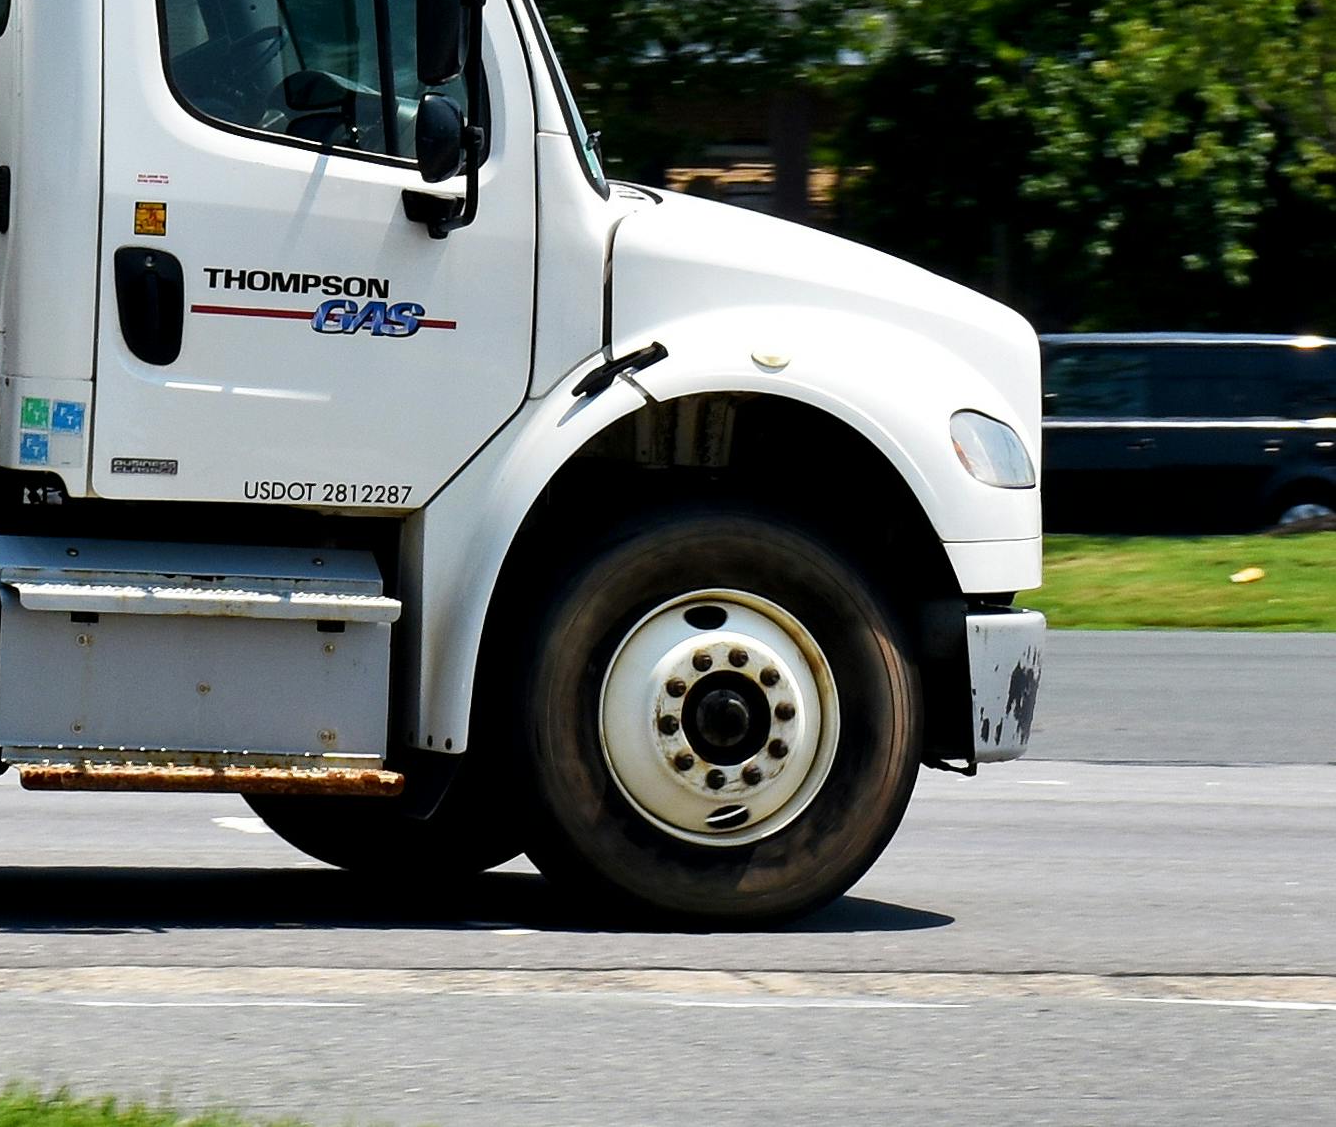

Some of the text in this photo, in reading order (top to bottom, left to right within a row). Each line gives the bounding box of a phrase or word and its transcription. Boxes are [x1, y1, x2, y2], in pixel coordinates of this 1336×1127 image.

[203, 267, 389, 299] THOMPSON
[310, 299, 426, 337] GAS
[244, 481, 413, 504] USDOT 2812287
